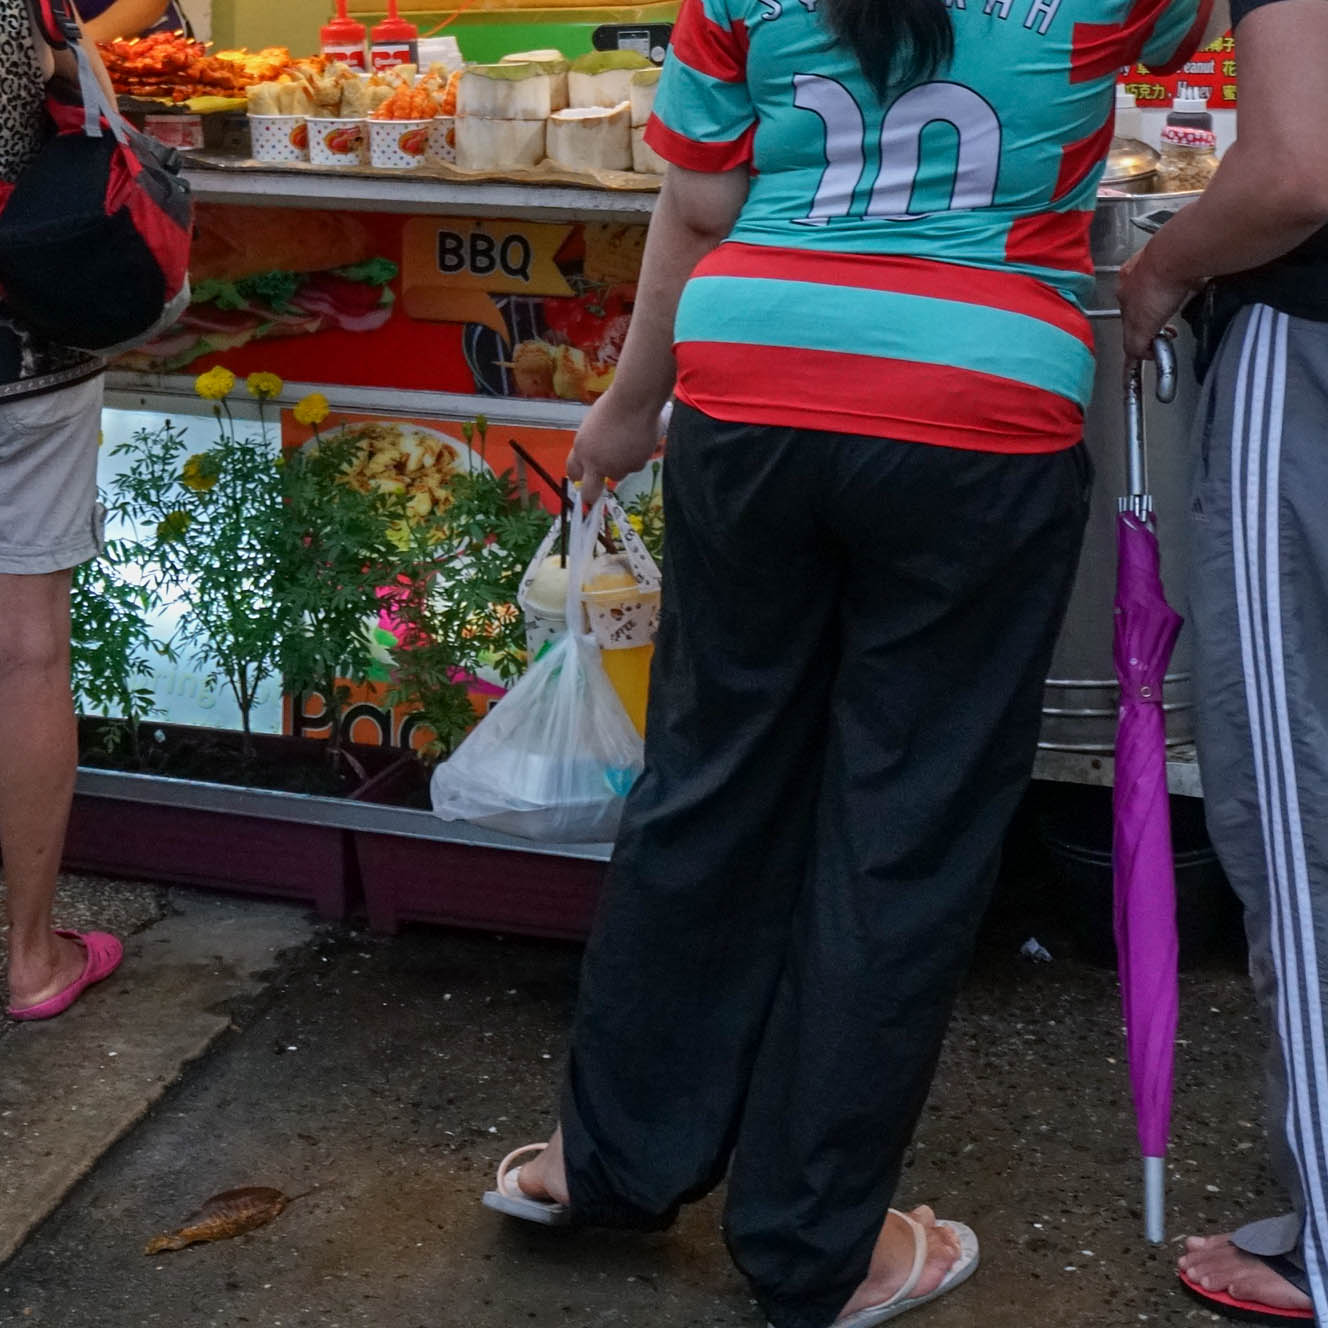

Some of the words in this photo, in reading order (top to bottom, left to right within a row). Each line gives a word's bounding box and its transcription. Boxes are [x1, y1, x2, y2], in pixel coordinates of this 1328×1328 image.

[1183, 58, 1215, 74] eanut
[792, 71, 1002, 226] 10
[435, 229, 534, 283] BBQ
